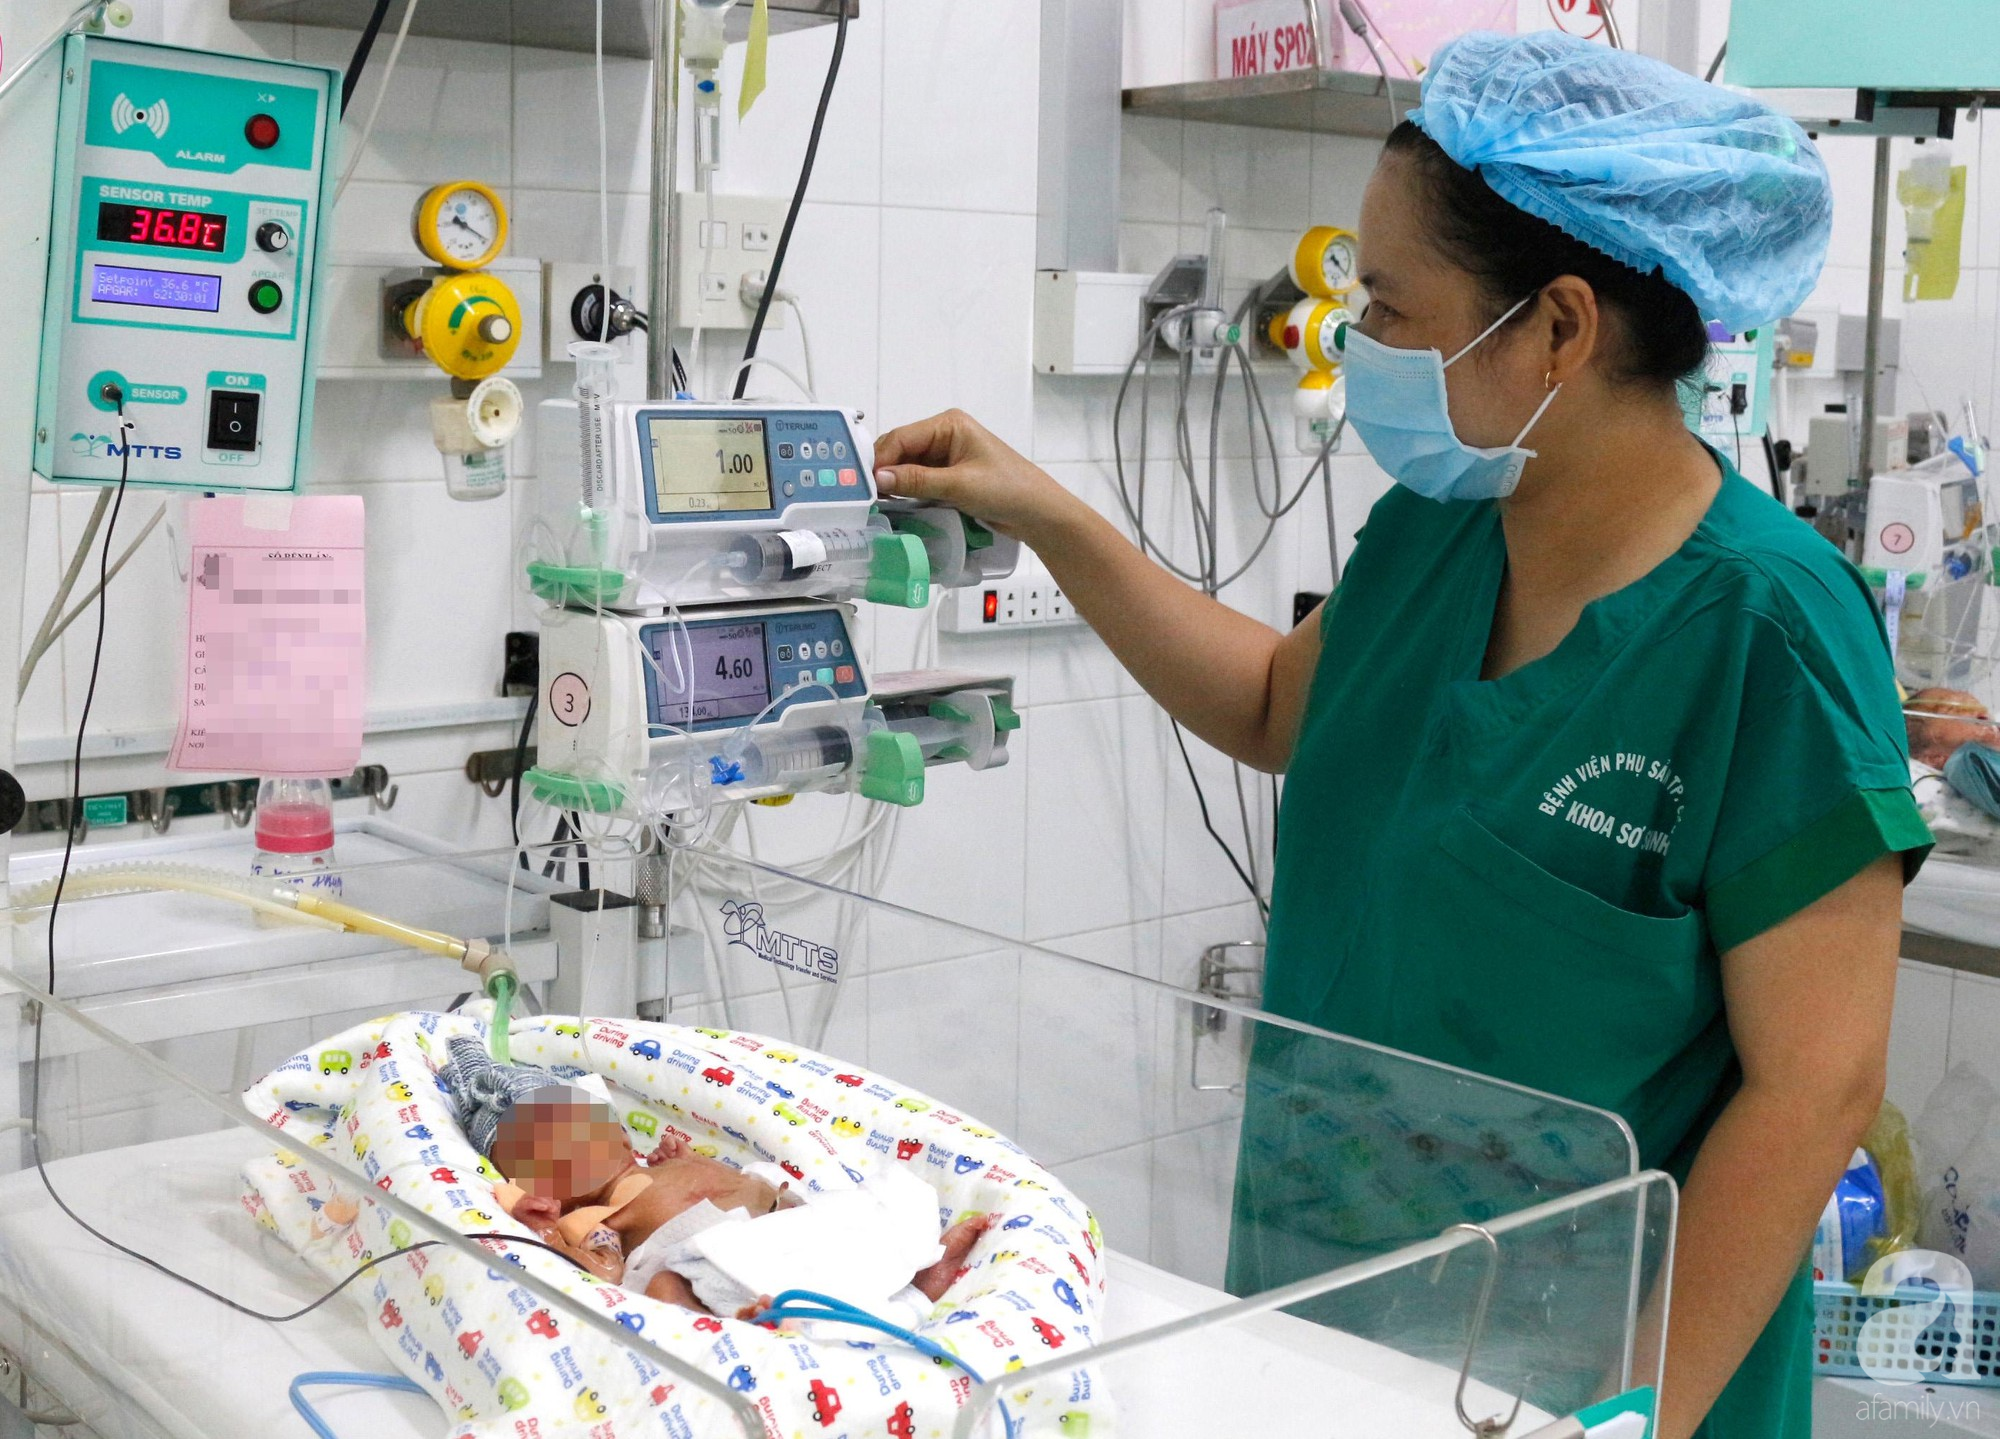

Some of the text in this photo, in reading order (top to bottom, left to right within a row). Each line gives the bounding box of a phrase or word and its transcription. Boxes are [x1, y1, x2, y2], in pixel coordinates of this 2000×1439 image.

[1232, 22, 1268, 78] MÁY
[175, 150, 226, 164] ALARM
[99, 185, 213, 208] SENSOR TEMP
[98, 272, 155, 288] Setpoint
[161, 277, 190, 291] 36.6
[251, 270, 286, 280] APGAR
[98, 284, 139, 298] APGAR:
[225, 375, 250, 386] ON
[131, 388, 180, 400] SENSOR
[106, 443, 182, 460] MTTS
[218, 453, 245, 463] OFF
[715, 449, 753, 475] 1.00
[1893, 534, 1902, 546] 7
[715, 655, 753, 681] 4.60
[564, 693, 574, 713] 3
[1538, 774, 1578, 816] BỆNH
[1575, 755, 1611, 782] VIỆN
[1616, 752, 1646, 777] PHỤ
[1565, 800, 1616, 838] KHOA
[1616, 823, 1647, 848] SƠ
[756, 925, 838, 975] MTTS
[593, 1033, 625, 1048] driving
[600, 1026, 629, 1040] During
[737, 1035, 764, 1048] During
[729, 1039, 758, 1052] driving
[666, 1056, 696, 1074] driving
[672, 1049, 700, 1066] During
[807, 1059, 834, 1072] During
[800, 1063, 828, 1076] driving
[736, 1086, 767, 1105] driving
[743, 1080, 772, 1099] During
[870, 1083, 896, 1097] During
[796, 1104, 823, 1123] During
[800, 1097, 830, 1117] driving
[664, 1124, 692, 1143] During
[870, 1129, 894, 1143] driving
[866, 1139, 890, 1155] During
[550, 1351, 574, 1390] During
[560, 1345, 583, 1382] driving
[877, 1354, 901, 1391] driving
[867, 1358, 891, 1397] During
